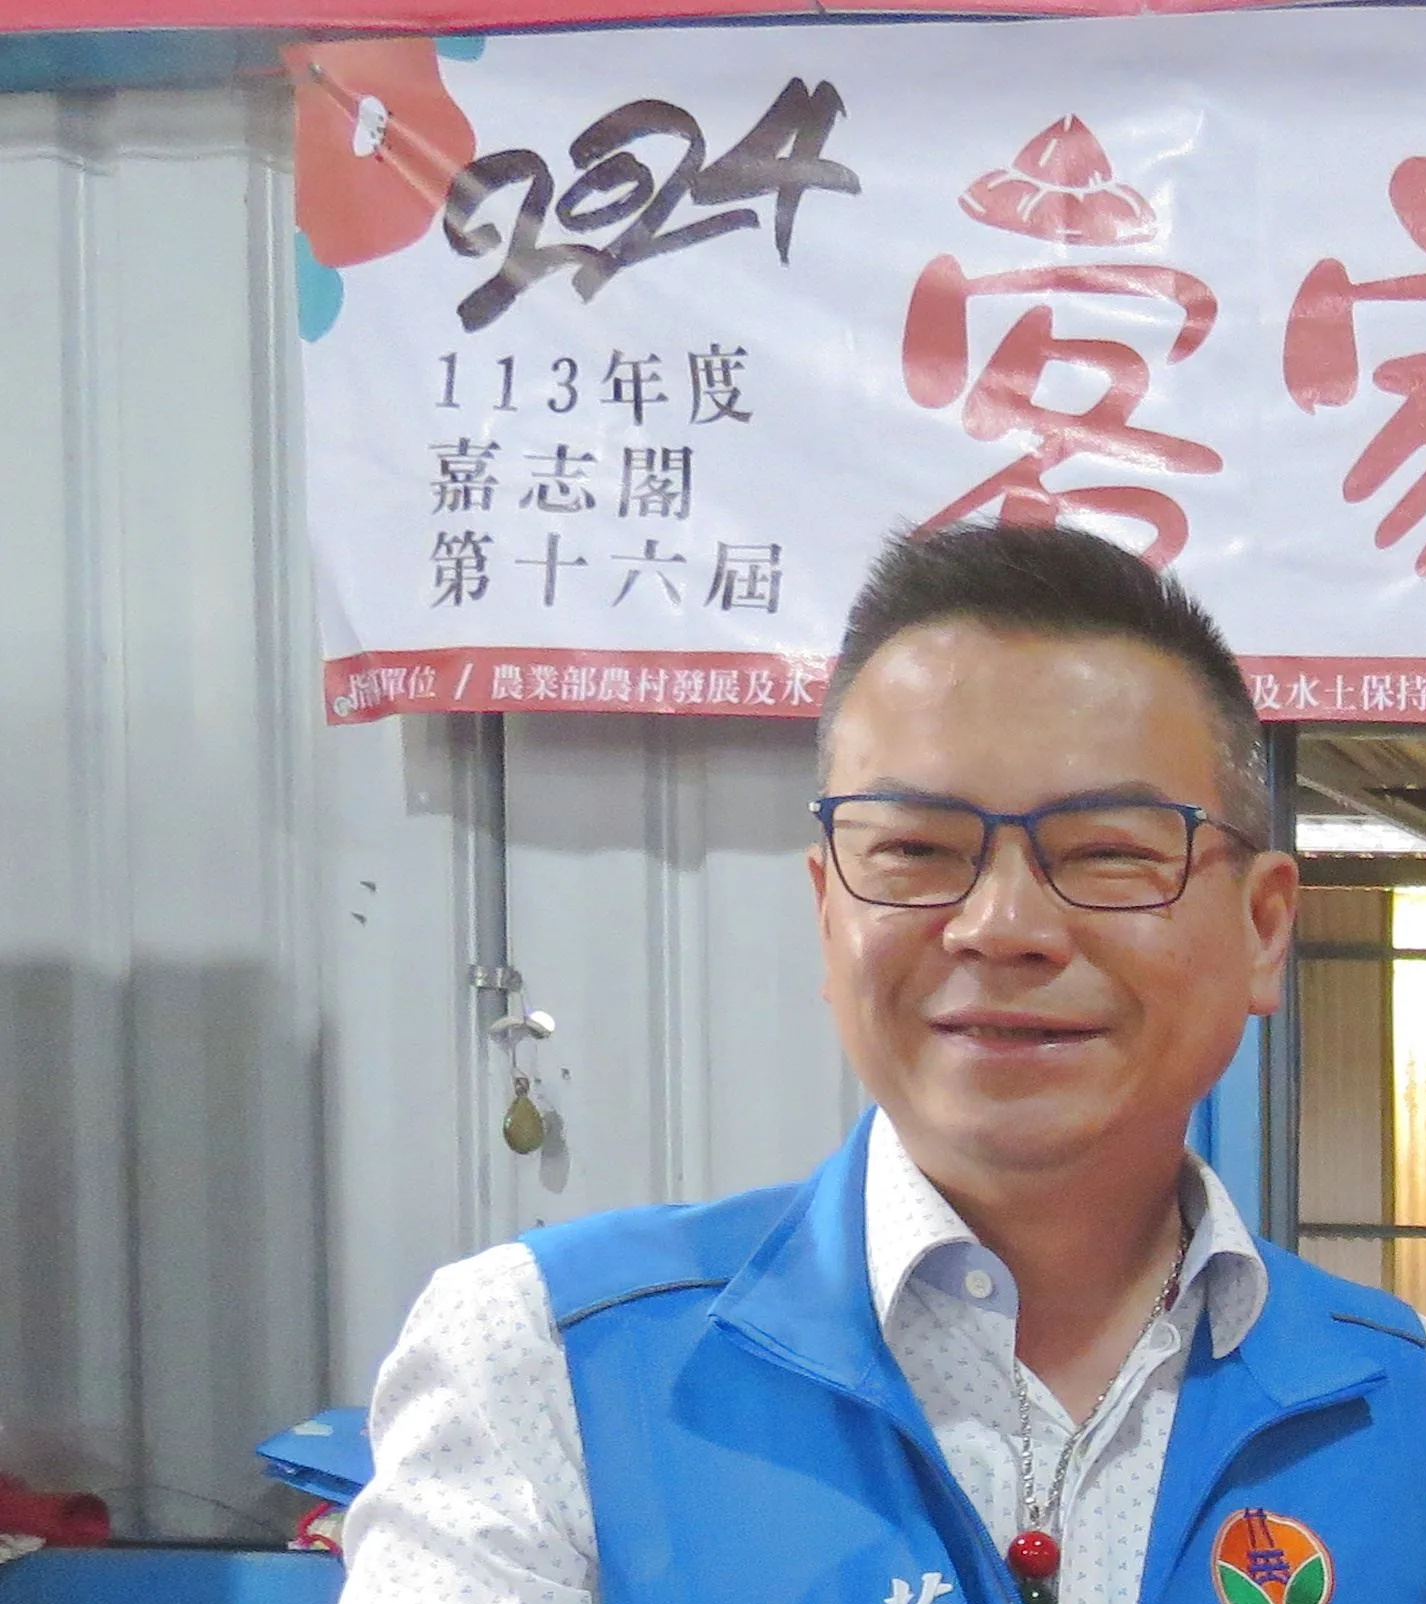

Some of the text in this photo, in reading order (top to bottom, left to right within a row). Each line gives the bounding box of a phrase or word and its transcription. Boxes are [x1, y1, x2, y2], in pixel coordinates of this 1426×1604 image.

[435, 343, 753, 427] 113年度
[429, 437, 695, 521] 嘉志閣
[428, 530, 785, 614] 第十六屆
